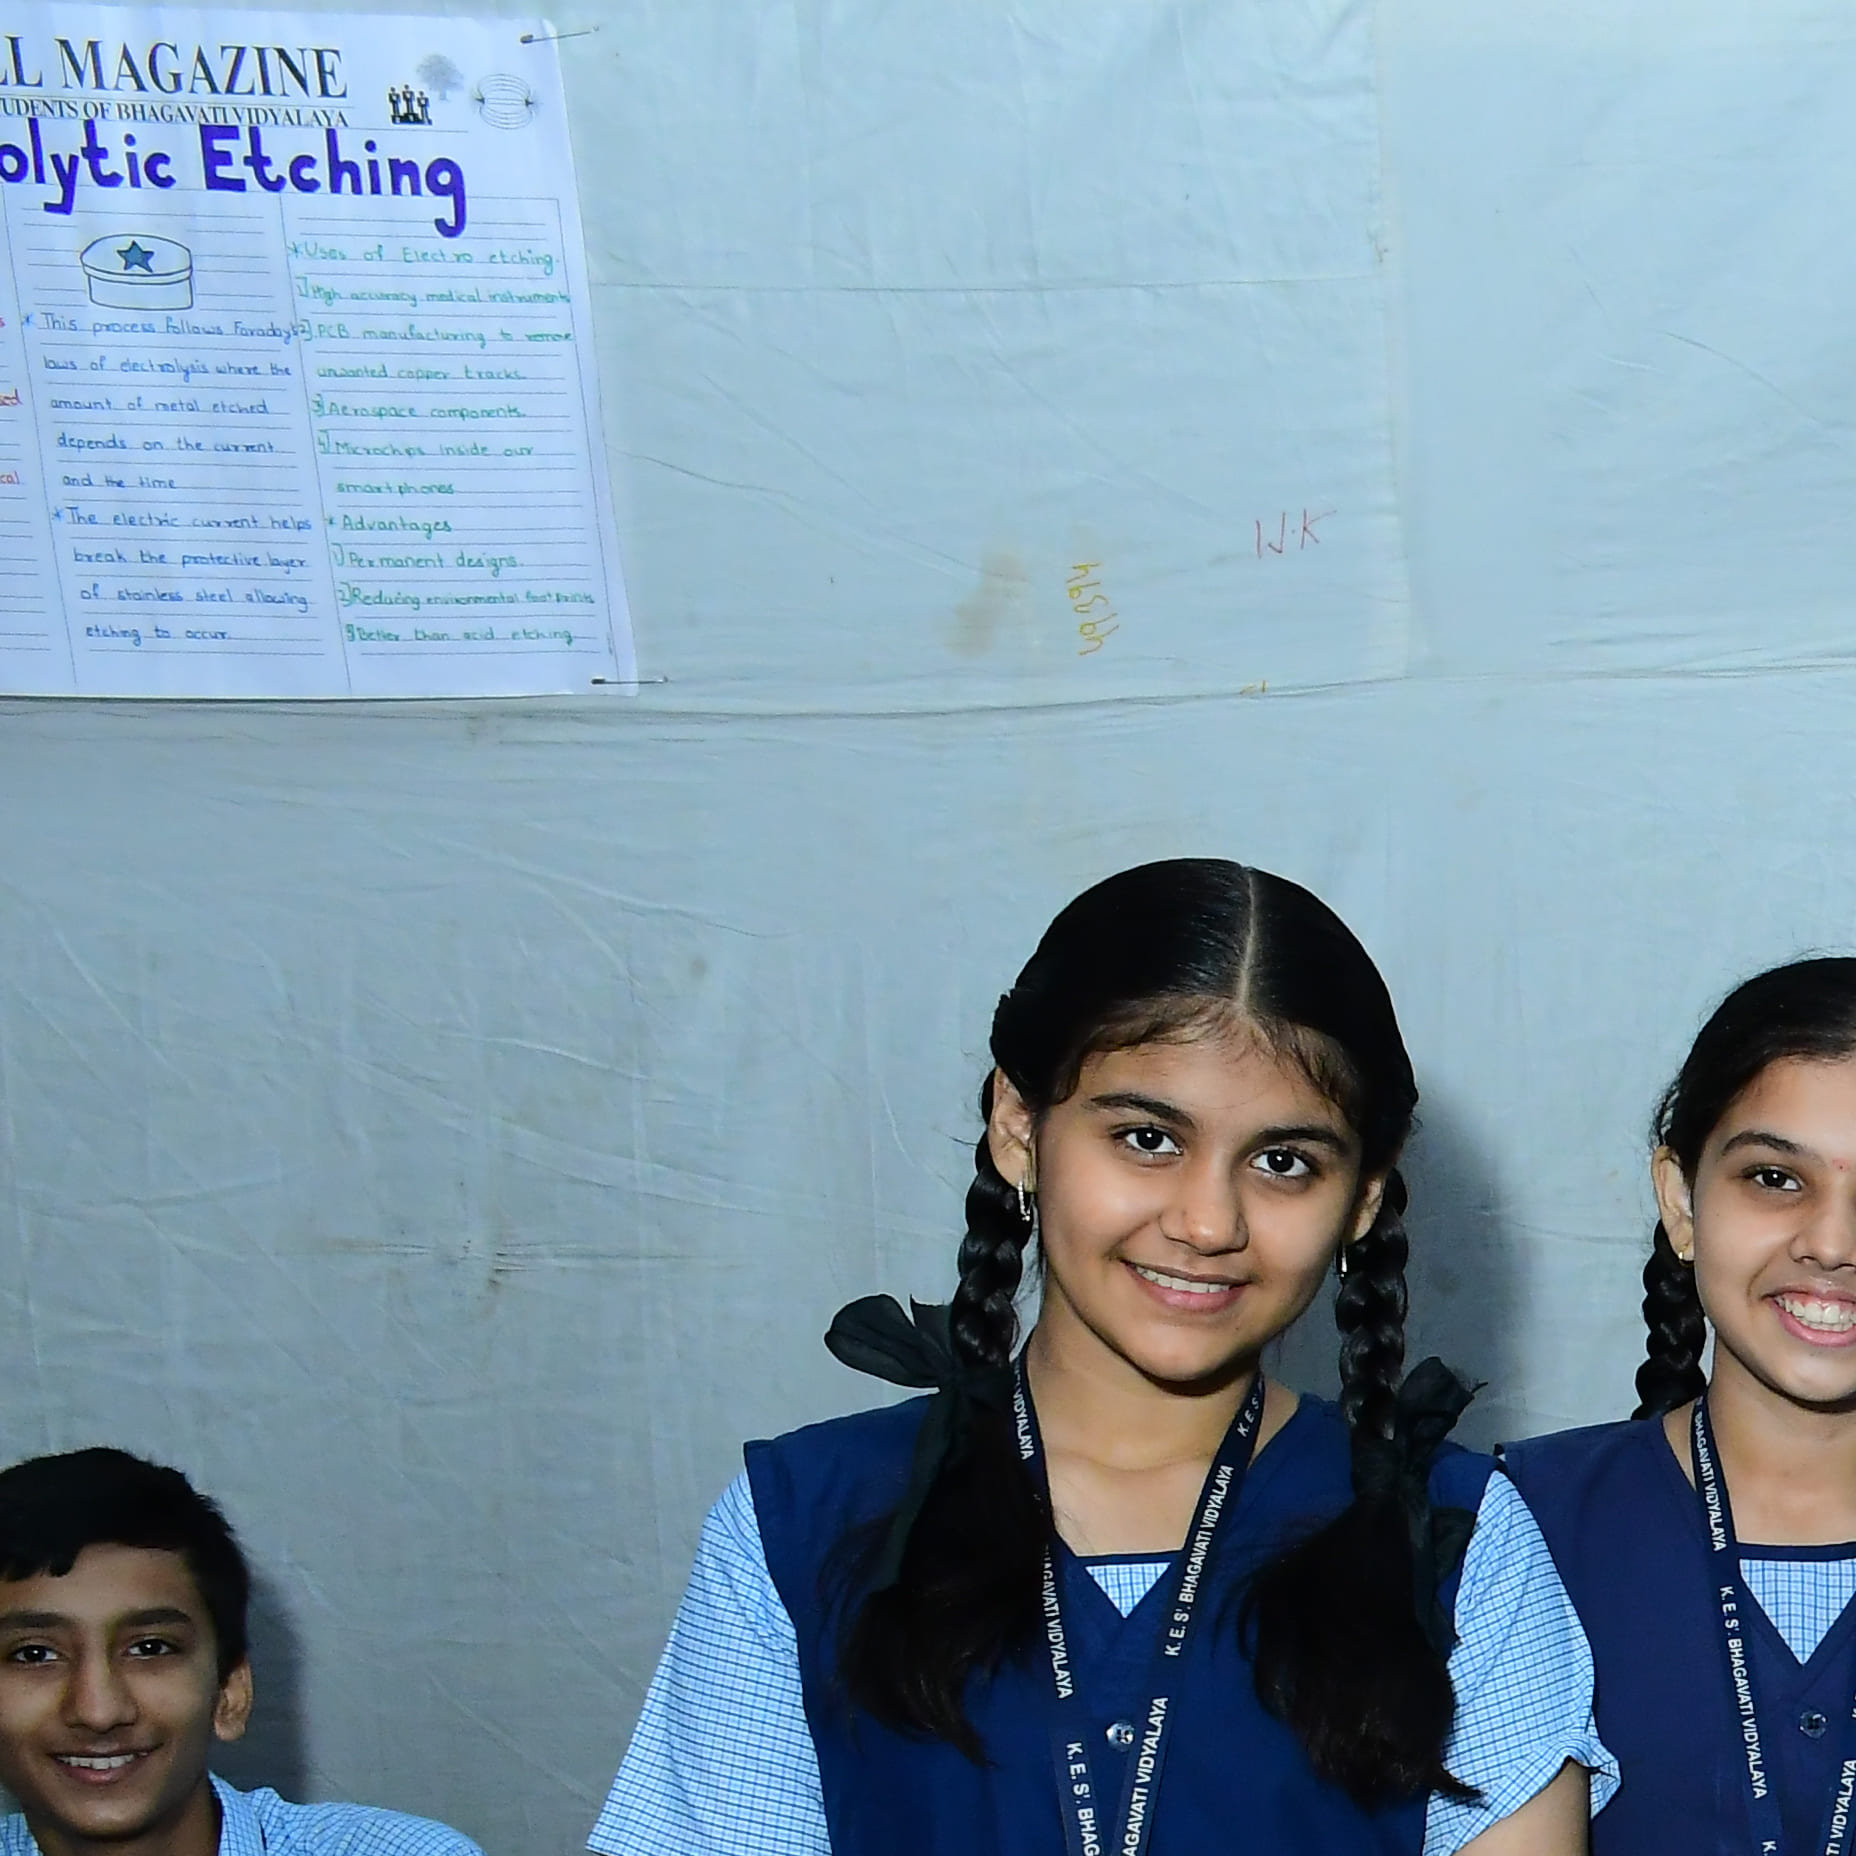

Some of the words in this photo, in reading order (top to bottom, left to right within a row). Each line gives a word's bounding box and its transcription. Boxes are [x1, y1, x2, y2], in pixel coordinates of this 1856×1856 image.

[54, 37, 348, 98] MAGAZINE
[84, 100, 110, 119] OF
[115, 103, 228, 124] BHAGAVATI
[228, 106, 349, 127] VIDYALAYA
[199, 123, 466, 238] Etching
[90, 356, 106, 370] of
[216, 362, 260, 375] where
[271, 361, 292, 376] the
[50, 399, 112, 410] amount
[128, 396, 142, 410] of
[155, 397, 200, 412] metal
[212, 400, 269, 414] etched
[58, 433, 127, 452] depends
[143, 441, 164, 450] on
[178, 438, 202, 450] the
[214, 442, 274, 453] current
[66, 506, 98, 525] The
[113, 513, 179, 527] electric
[192, 516, 258, 528] current
[270, 516, 312, 530] helps
[342, 515, 452, 540] Advantages
[1178, 1530, 1213, 1603] BHAGAVATI
[1200, 1464, 1234, 1529] VIDYALAYA
[1727, 1638, 1753, 1717] BHAGAVATI
[1742, 1718, 1767, 1798] VIDYALAYA
[1138, 1697, 1169, 1784] VIDYALAYA
